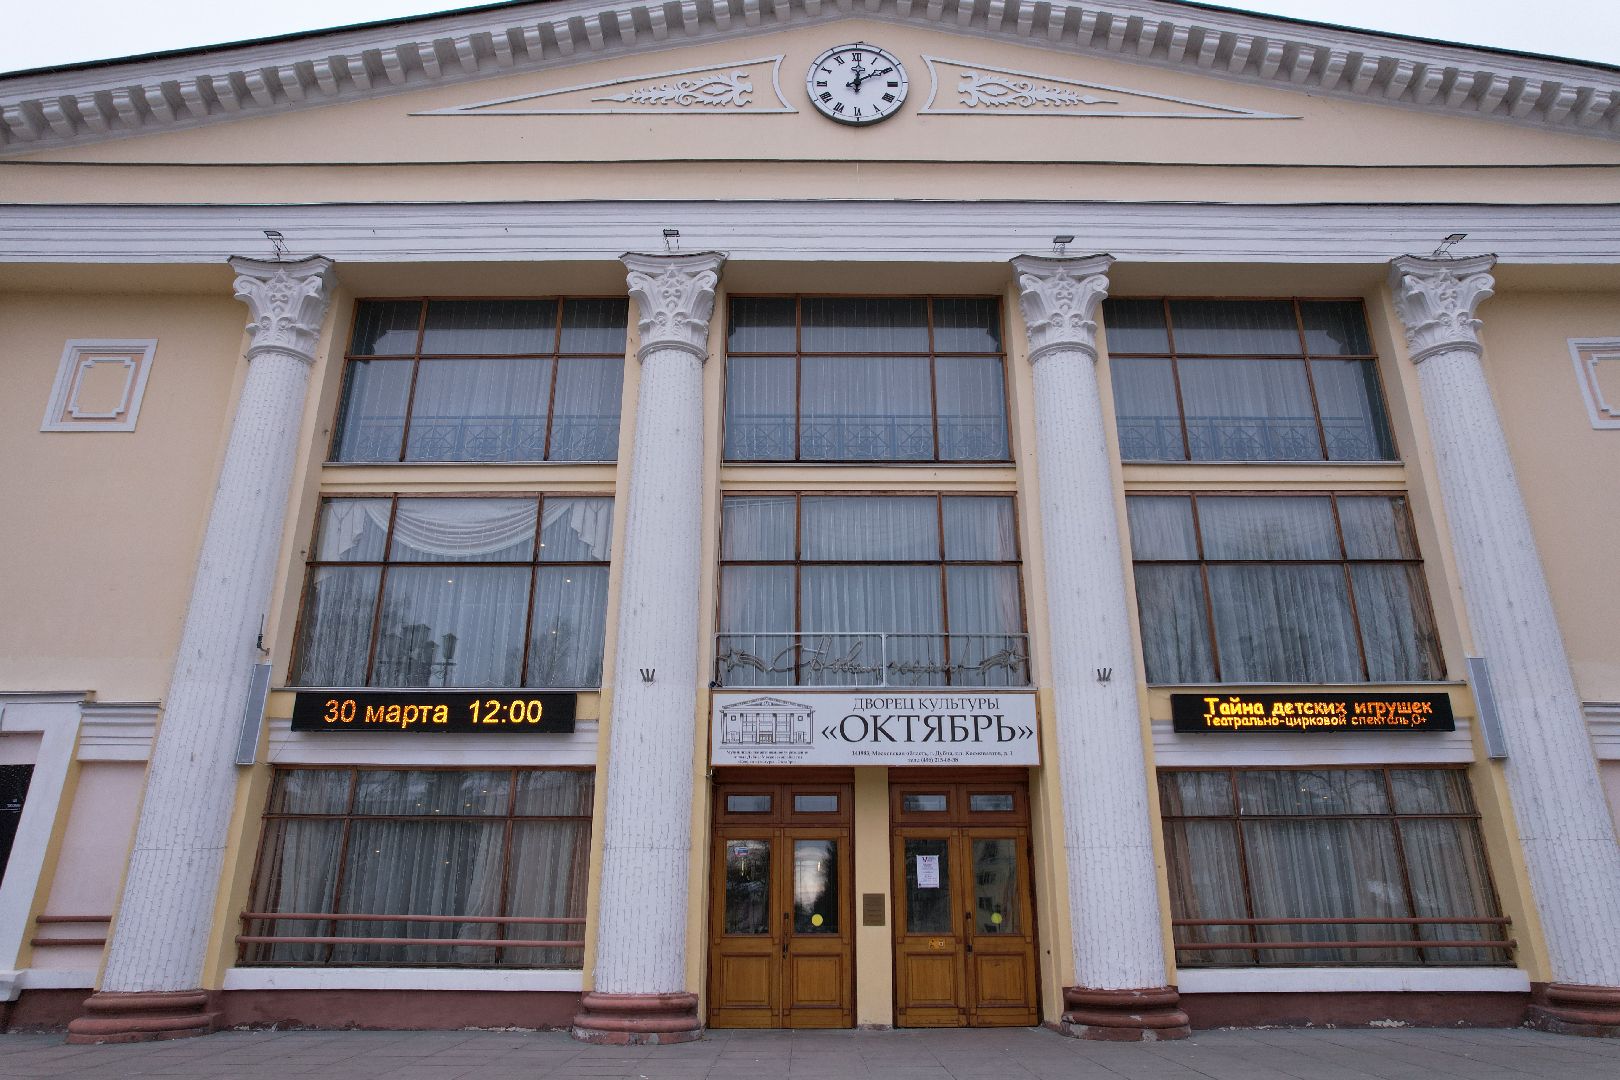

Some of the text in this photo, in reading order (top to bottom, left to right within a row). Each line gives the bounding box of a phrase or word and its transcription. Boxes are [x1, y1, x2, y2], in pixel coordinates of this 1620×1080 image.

[873, 104, 880, 113] V
[324, 699, 542, 728] 30 марта 12:00
[853, 698, 1000, 712] ДВОРЕЦ КУЛЬТУРЫ
[1204, 697, 1432, 719] Тайна детских игрушек
[822, 714, 1033, 743] «ОКТЯБРЬ»
[1204, 714, 1347, 729] Театрально-цирковой
